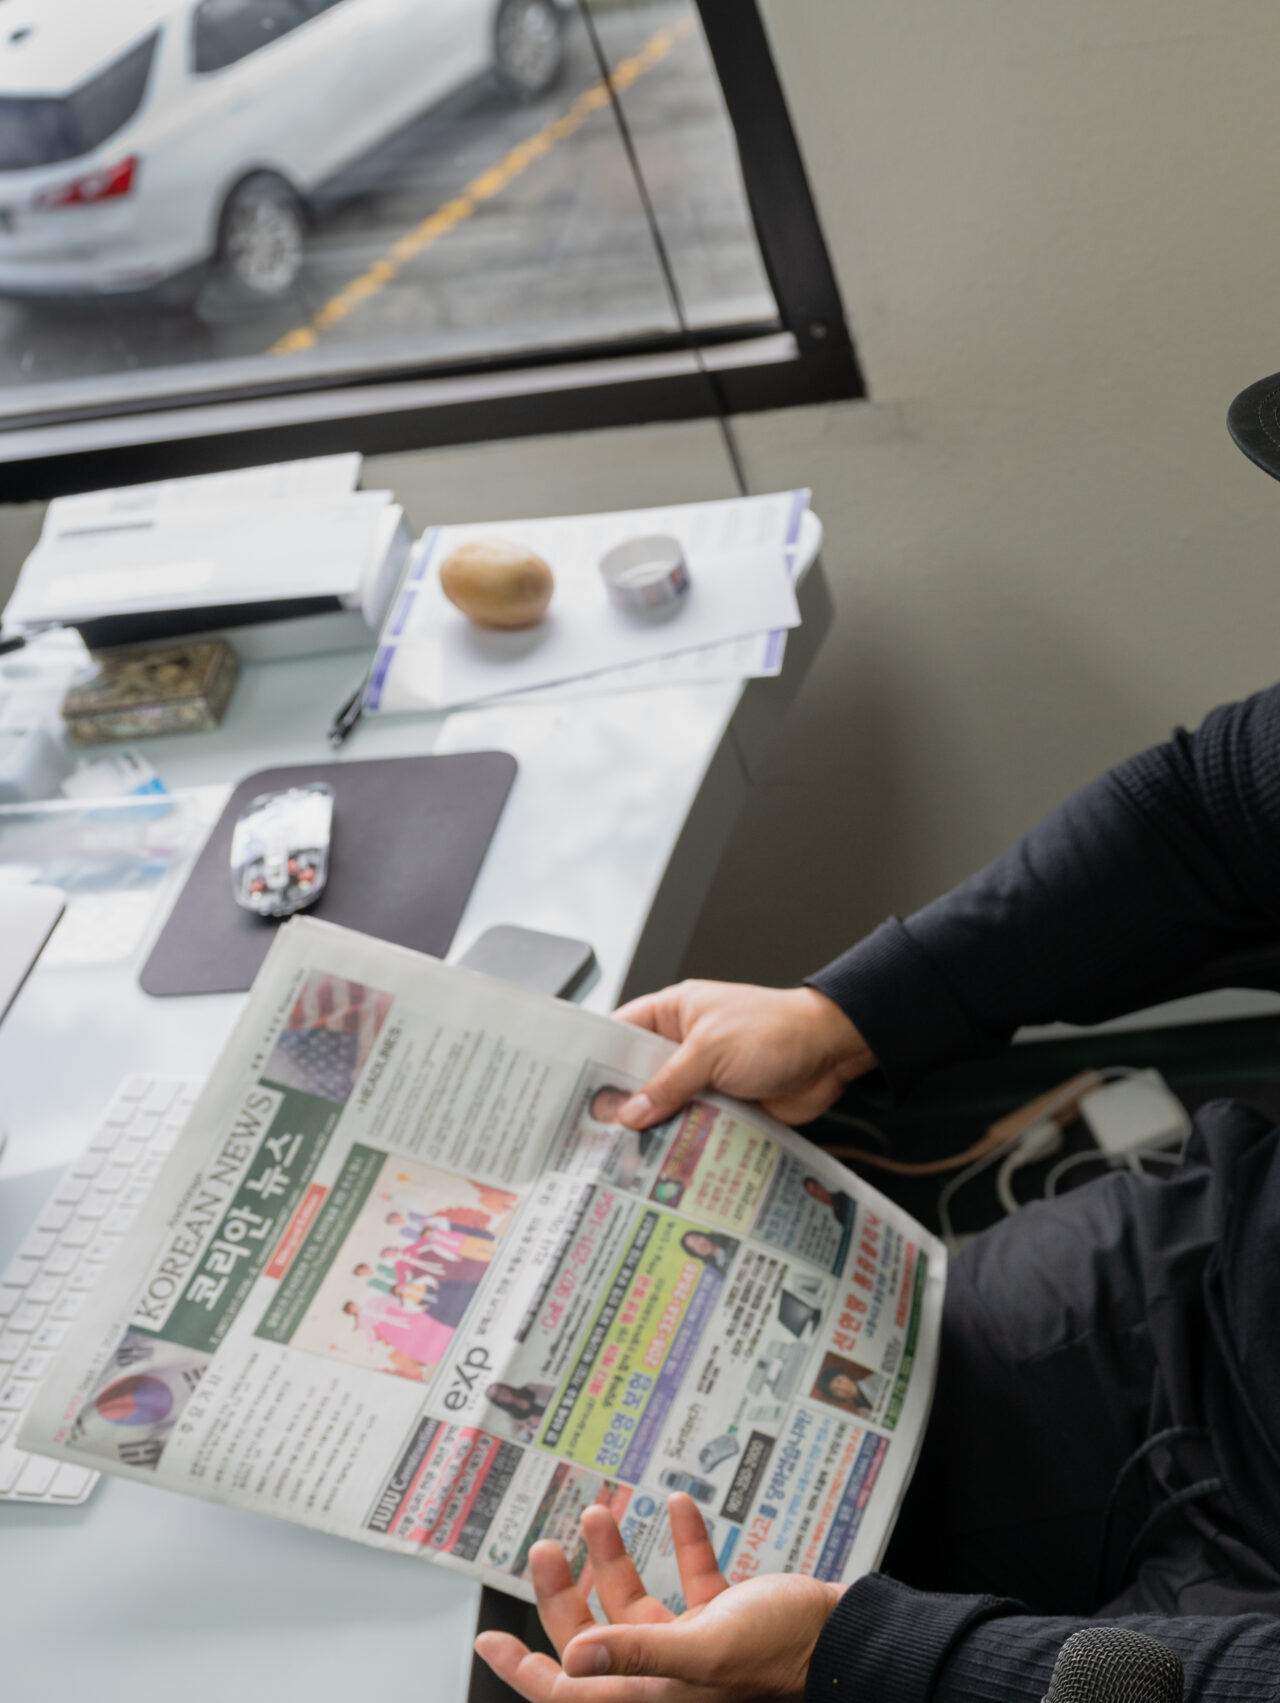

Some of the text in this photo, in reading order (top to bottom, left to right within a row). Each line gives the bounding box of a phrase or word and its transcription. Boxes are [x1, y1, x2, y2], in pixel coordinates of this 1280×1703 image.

[134, 1188, 224, 1320] KOREAN
[209, 1091, 275, 1187] NEWS
[184, 1204, 273, 1311] 코리안
[244, 1132, 301, 1198] 뉴스
[370, 1489, 403, 1530] JUJU
